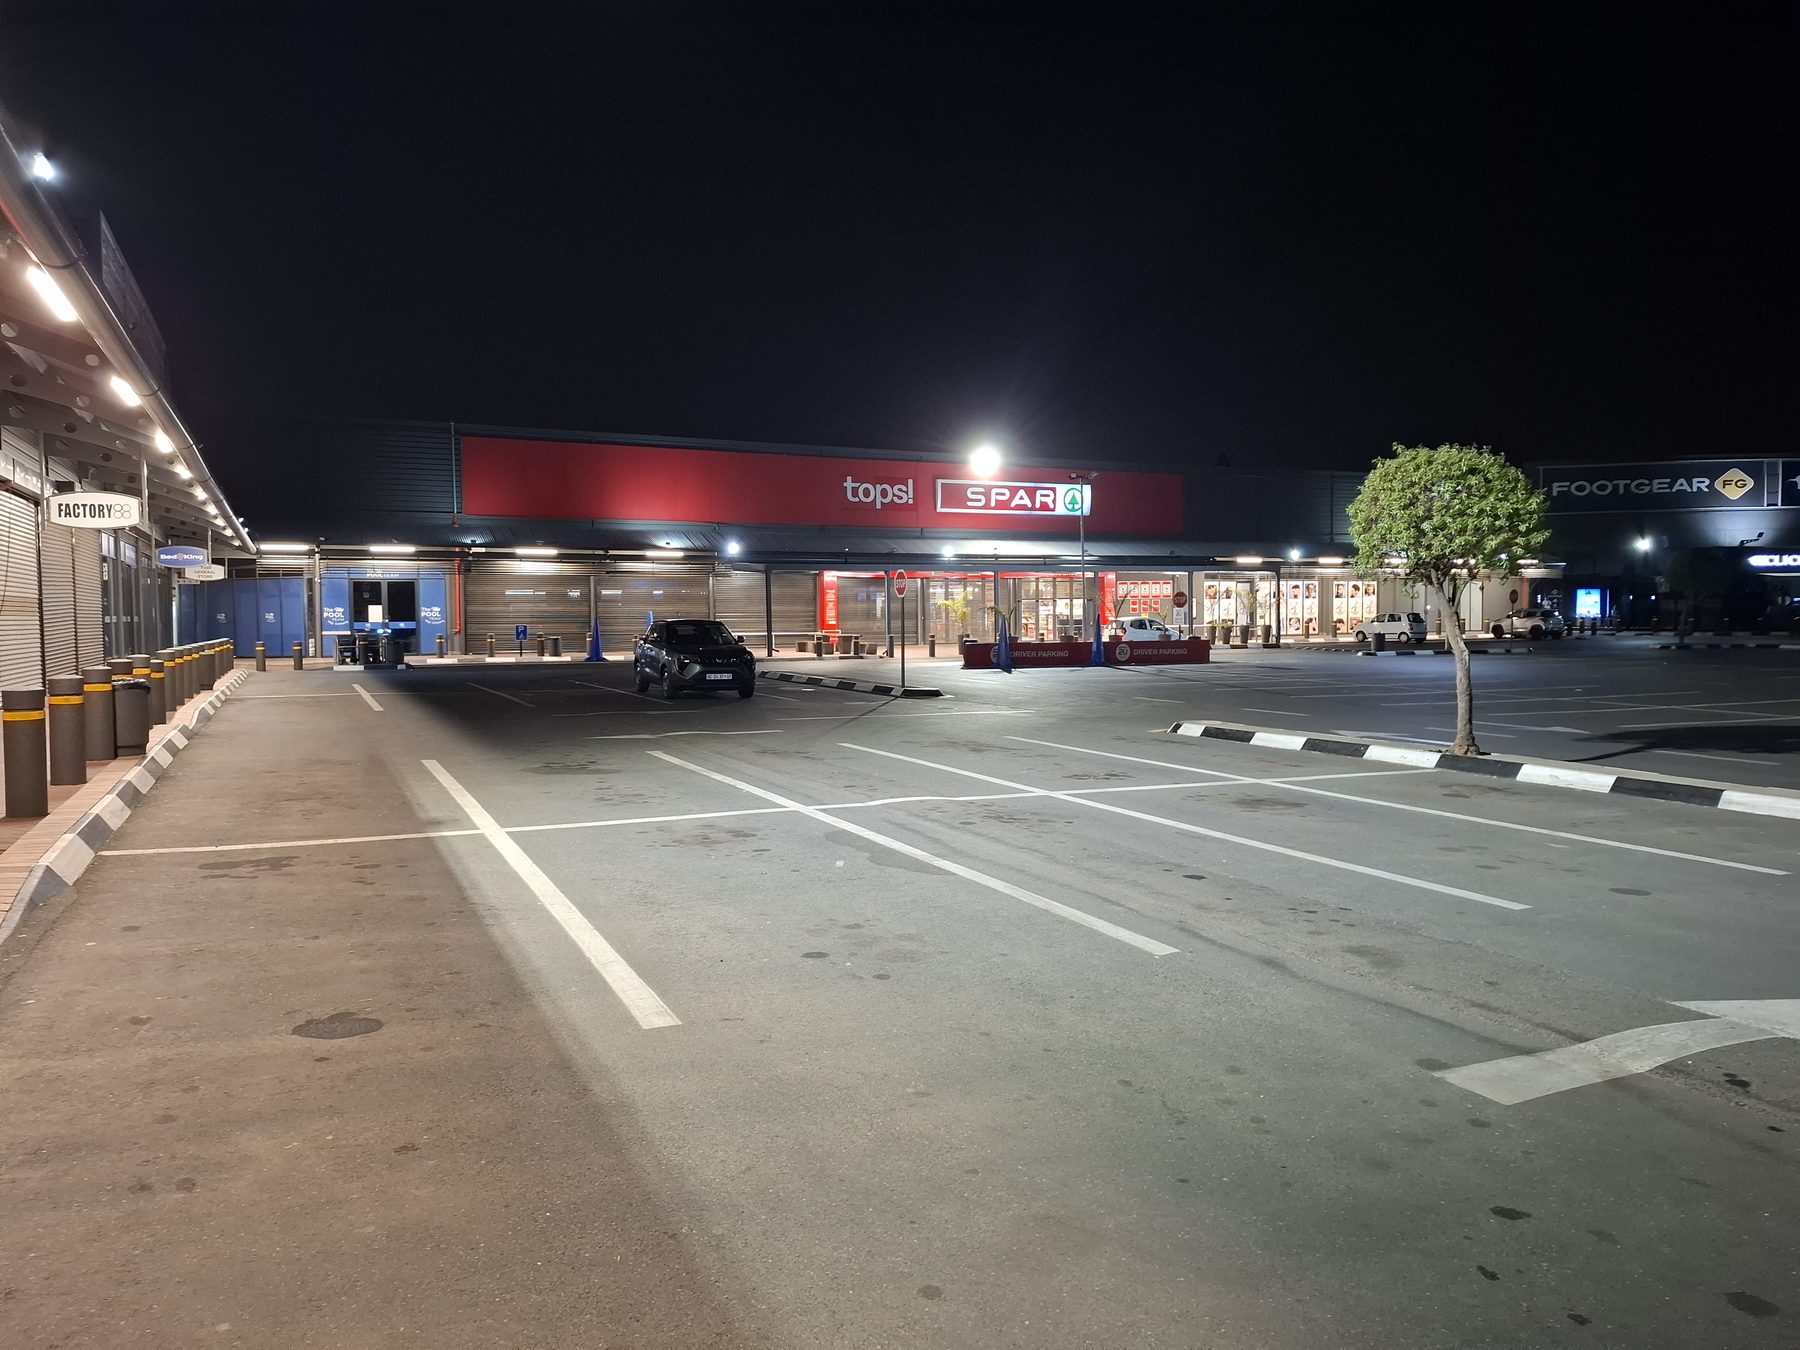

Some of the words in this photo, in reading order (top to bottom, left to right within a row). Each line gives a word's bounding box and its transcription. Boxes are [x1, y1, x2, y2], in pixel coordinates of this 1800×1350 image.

[843, 476, 913, 509] tops!
[1552, 477, 1710, 496] FOOTGEAR
[1722, 479, 1748, 489] FG
[966, 488, 1055, 509] SPAR
[896, 579, 906, 589] STOP
